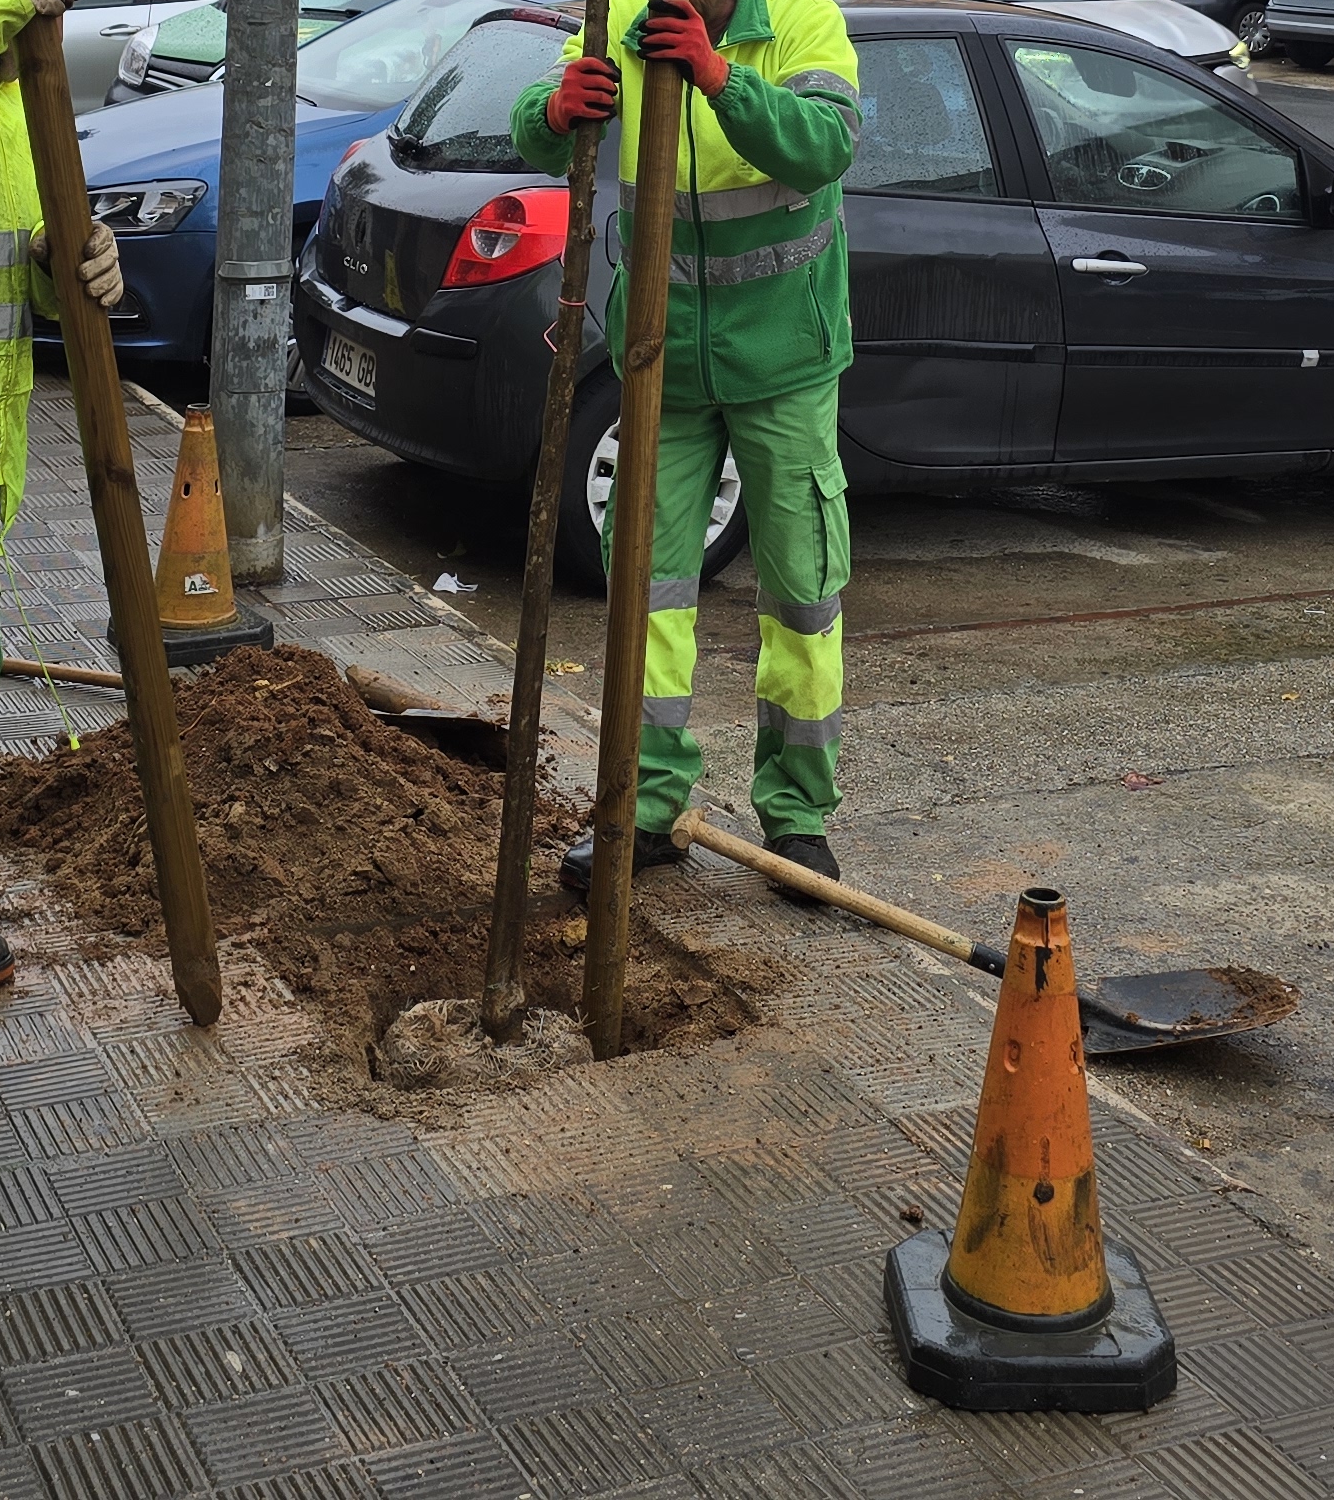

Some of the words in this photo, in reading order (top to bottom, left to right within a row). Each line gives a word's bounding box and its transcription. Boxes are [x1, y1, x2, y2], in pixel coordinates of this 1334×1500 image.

[343, 255, 368, 275] CLIO
[329, 336, 355, 377] 1465
[357, 352, 377, 391] GB
